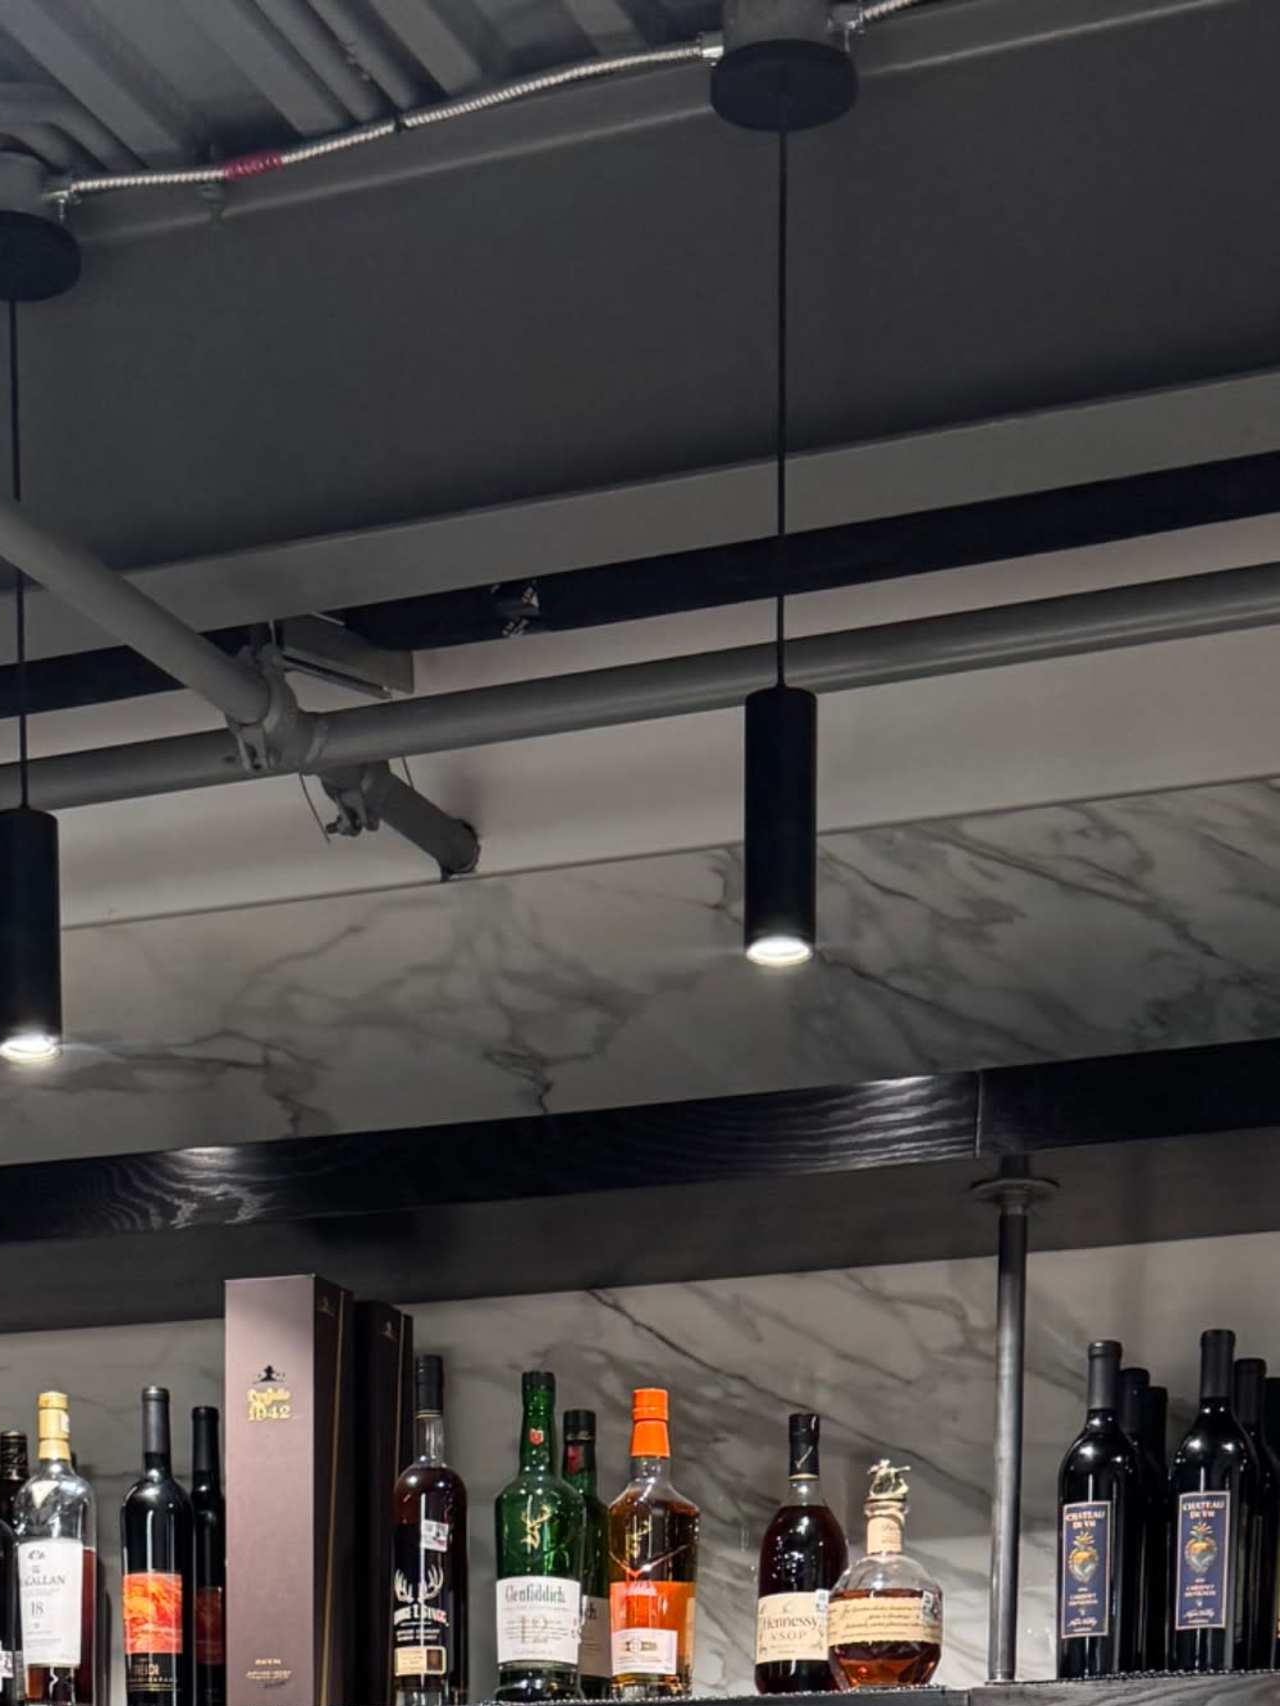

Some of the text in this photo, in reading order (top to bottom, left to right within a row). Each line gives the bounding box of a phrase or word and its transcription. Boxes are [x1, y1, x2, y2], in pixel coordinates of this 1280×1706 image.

[505, 1582, 566, 1603] Glenfiddich
[30, 1601, 44, 1616] 18
[763, 1616, 818, 1630] Hennessy
